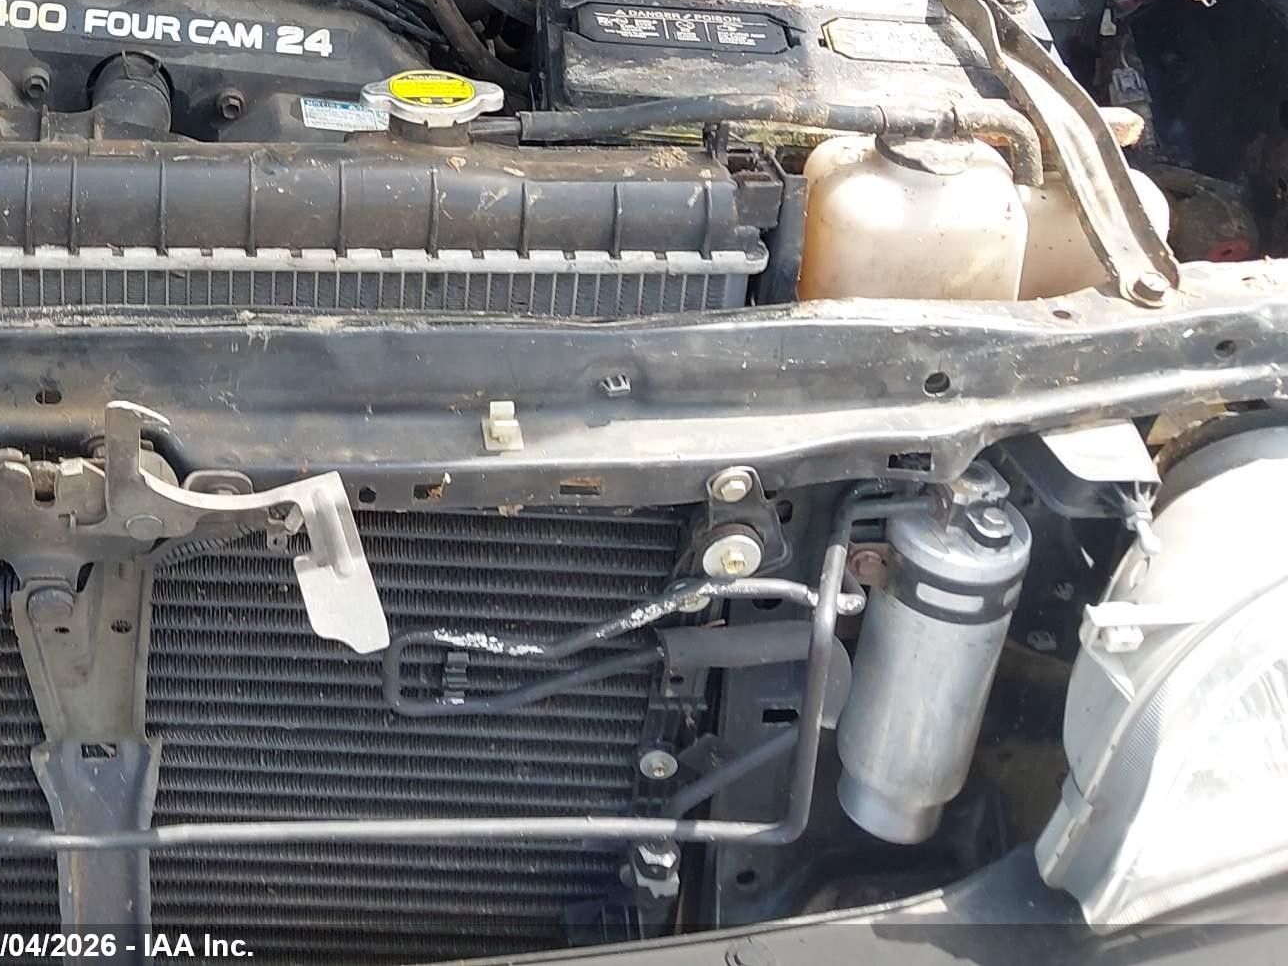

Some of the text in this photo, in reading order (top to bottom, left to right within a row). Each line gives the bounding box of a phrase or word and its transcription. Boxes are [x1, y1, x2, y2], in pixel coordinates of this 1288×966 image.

[627, 9, 681, 20] DANGER
[693, 13, 742, 23] POISON
[84, 8, 182, 42] FOUR
[188, 18, 263, 50] CAM
[275, 25, 333, 57] 24
